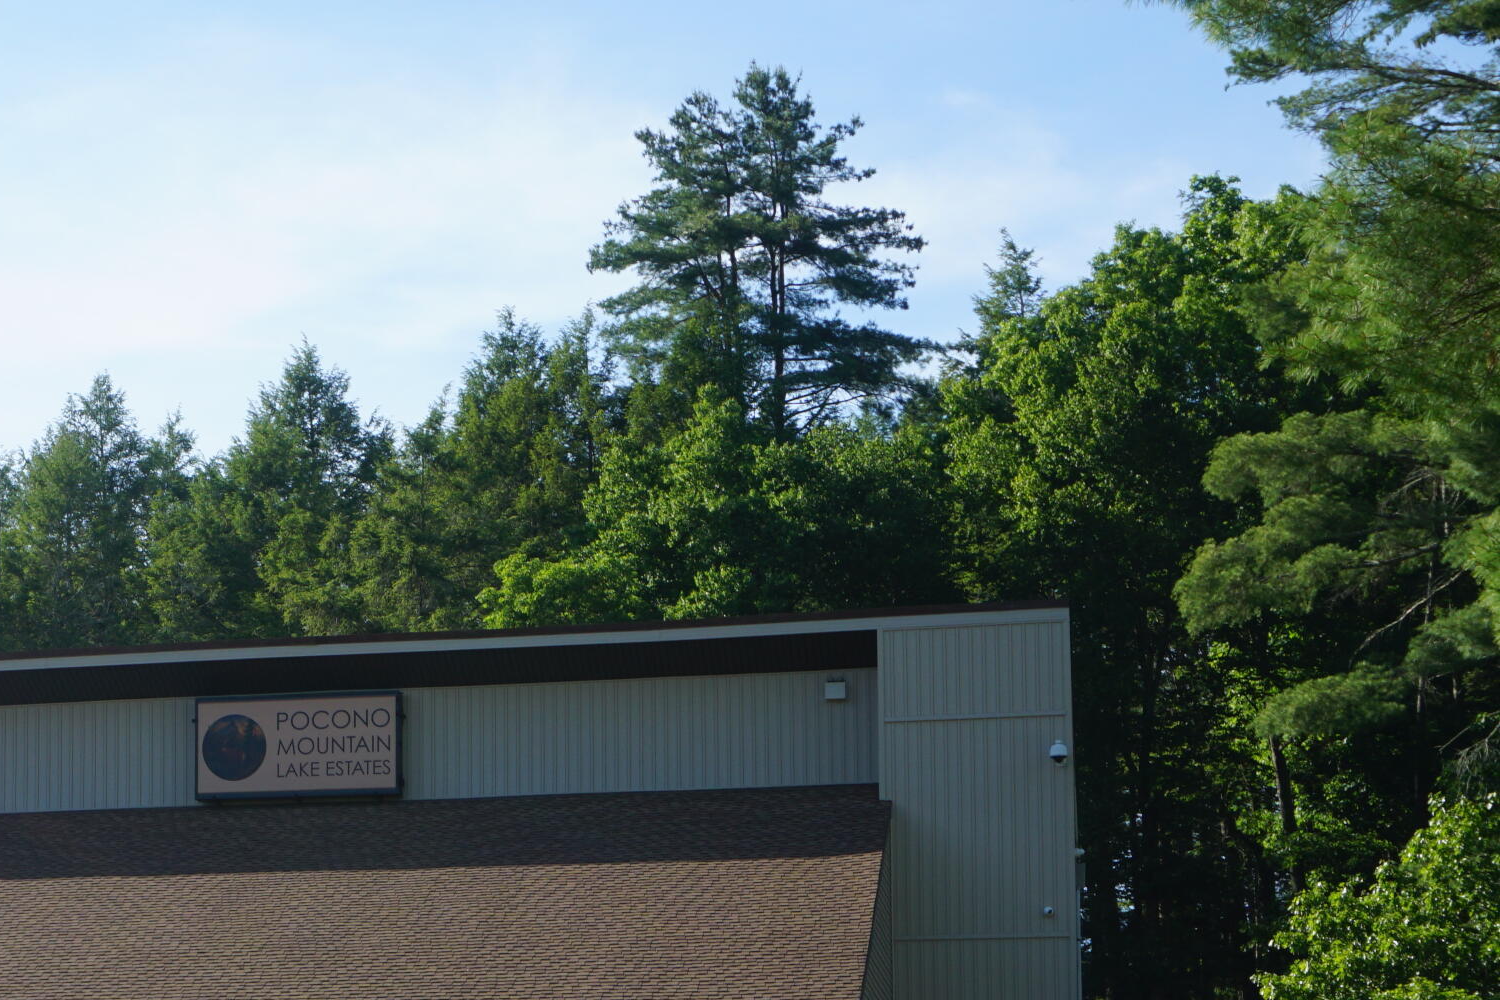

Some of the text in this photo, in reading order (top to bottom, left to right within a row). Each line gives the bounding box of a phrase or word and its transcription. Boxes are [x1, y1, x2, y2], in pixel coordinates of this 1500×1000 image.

[276, 708, 391, 731] POCONO
[277, 734, 391, 756] MOUNTAIN
[276, 759, 391, 778] LAKE ESTATES
